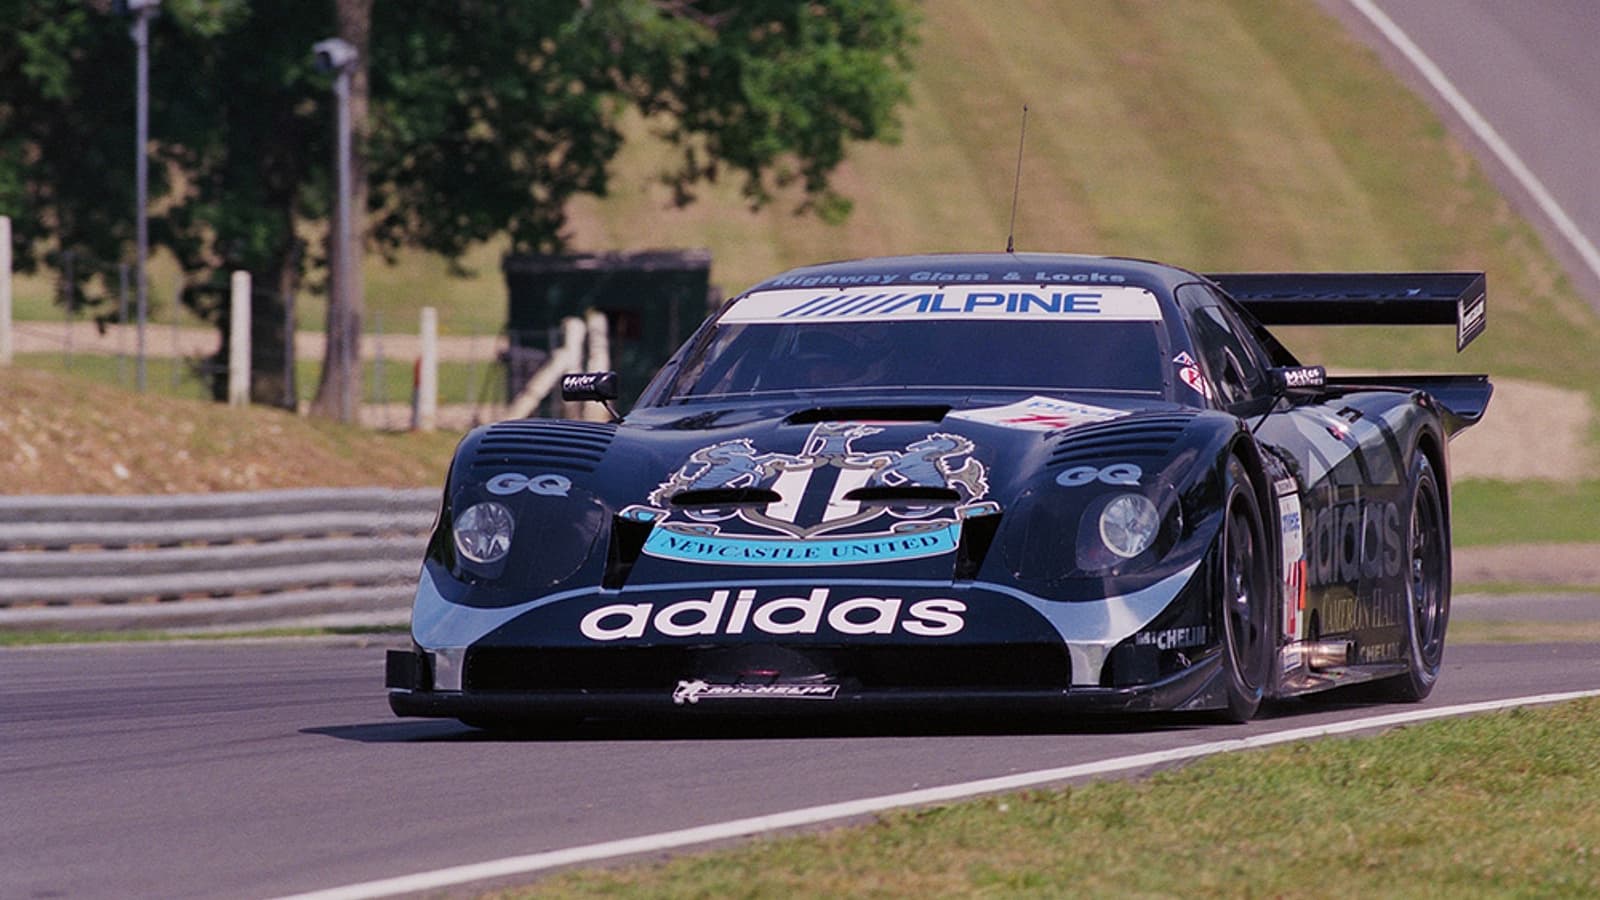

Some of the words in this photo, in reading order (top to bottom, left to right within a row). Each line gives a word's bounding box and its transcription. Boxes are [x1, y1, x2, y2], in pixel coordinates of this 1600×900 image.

[772, 273, 899, 286] Highway
[909, 271, 989, 281] Glass
[1003, 272, 1020, 281] &
[1035, 272, 1125, 282] Locks
[880, 293, 1102, 313] ALPINE
[485, 472, 573, 497] GQ
[1056, 463, 1143, 487] GQ
[660, 536, 820, 559] NEWCASTLE
[832, 535, 940, 558] UNITED
[579, 588, 968, 641] adidas
